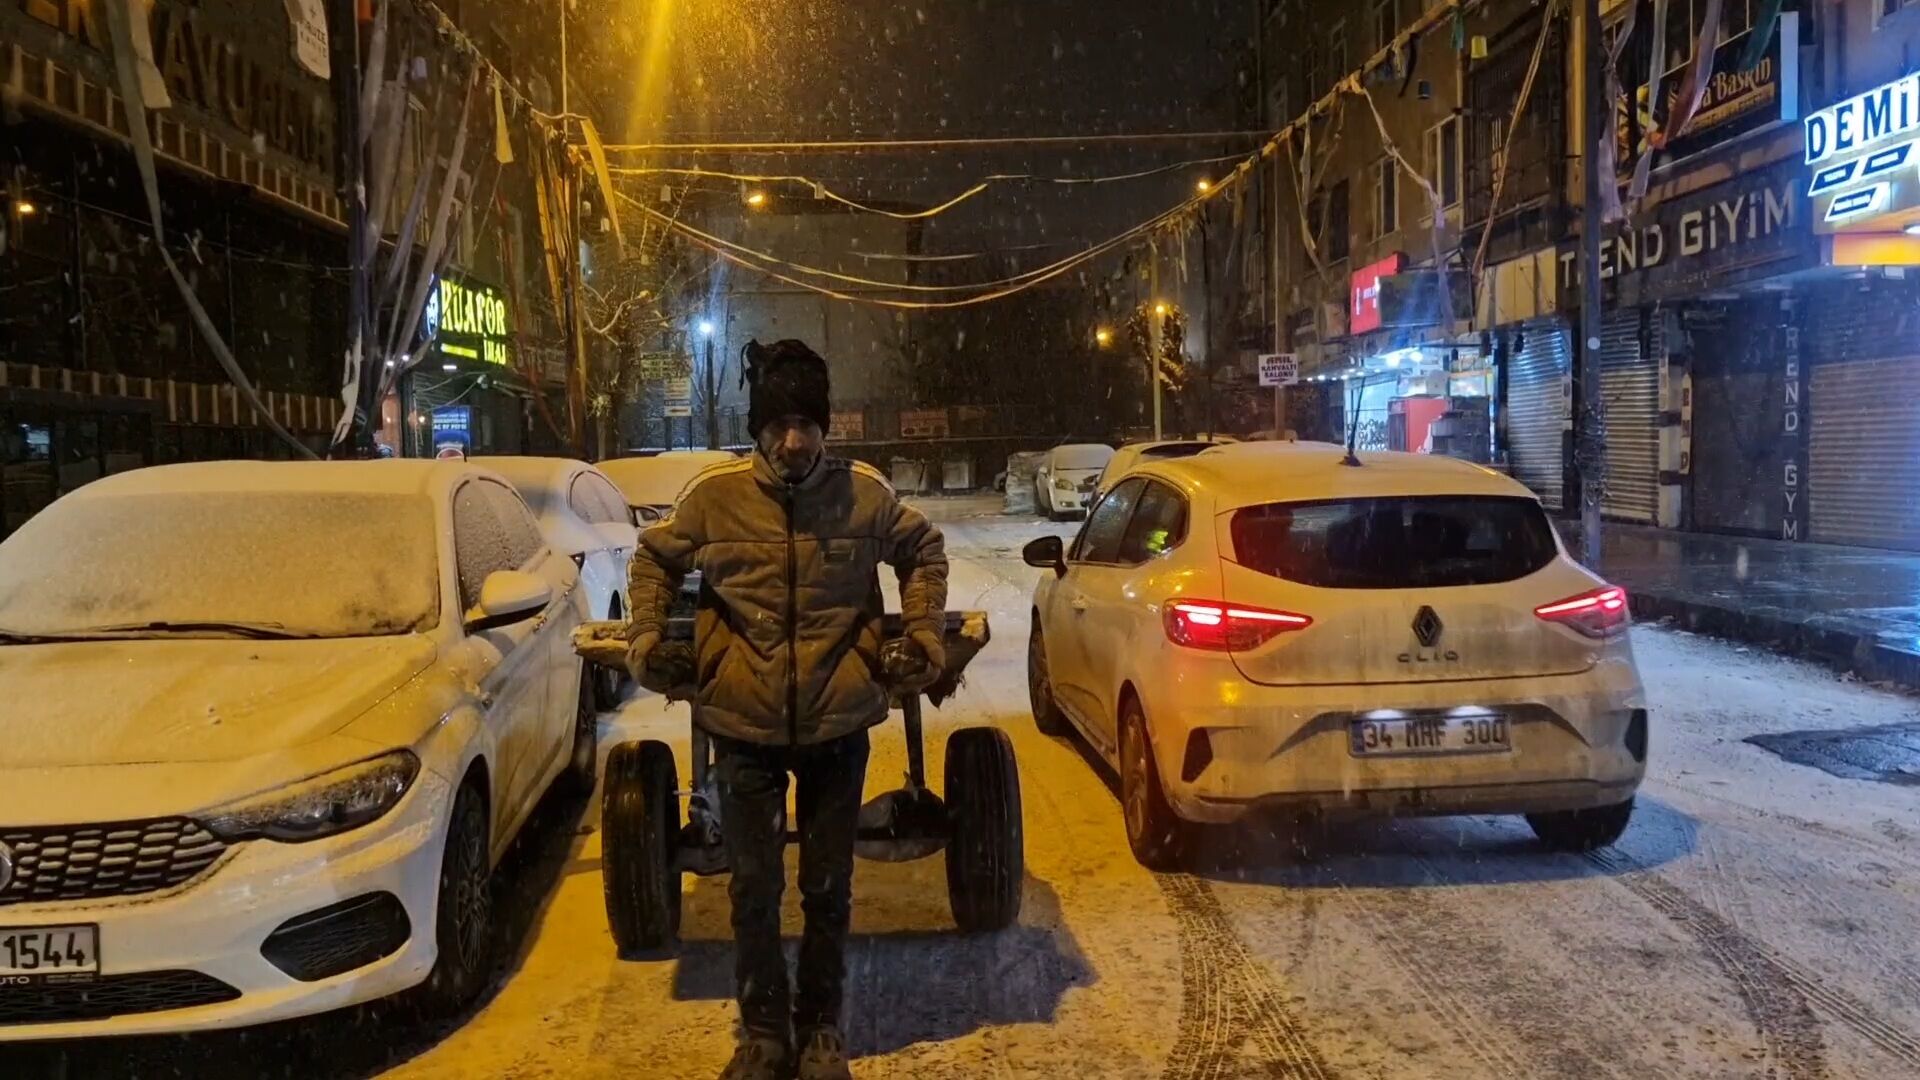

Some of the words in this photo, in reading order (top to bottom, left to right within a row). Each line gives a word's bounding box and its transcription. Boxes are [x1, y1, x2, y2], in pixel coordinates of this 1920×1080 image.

[1806, 76, 1920, 163] DEMİ
[1560, 224, 1663, 289] TEND
[1680, 180, 1800, 256] GİYİM
[1783, 464, 1798, 541] GYM
[1397, 650, 1459, 664] CLIO
[1363, 721, 1393, 748] 34
[1462, 719, 1506, 745] 300
[3, 932, 86, 970] 1544
